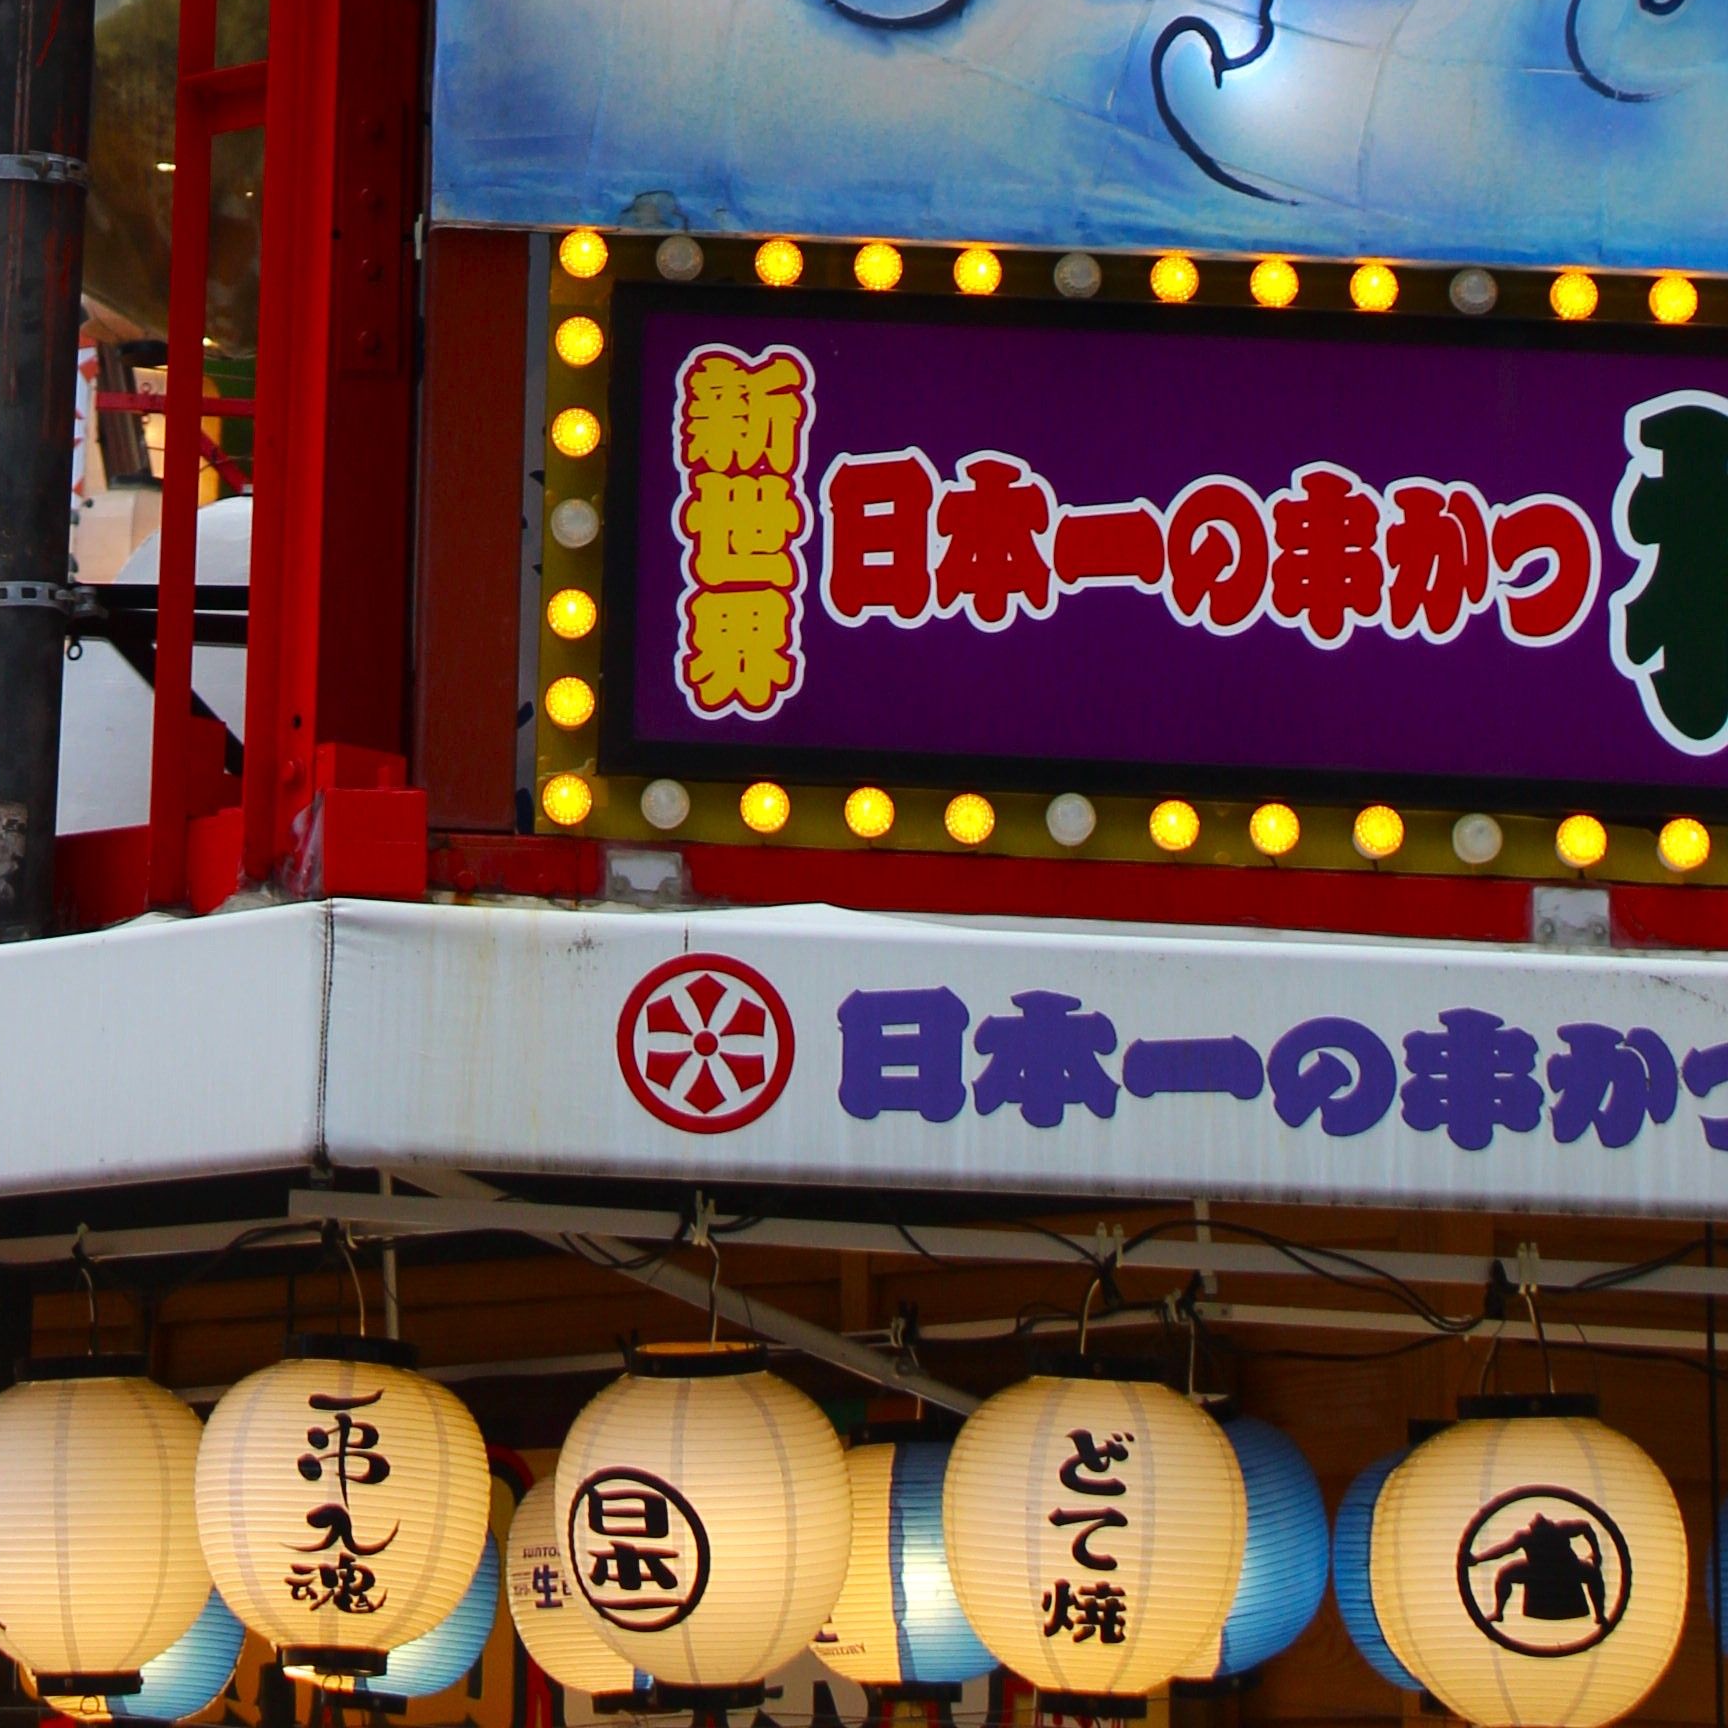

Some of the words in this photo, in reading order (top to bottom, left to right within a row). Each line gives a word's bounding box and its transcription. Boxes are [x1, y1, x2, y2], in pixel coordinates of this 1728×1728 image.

[680, 350, 810, 714] 新世界
[825, 450, 1597, 644] 日本一の串かつ
[280, 1386, 402, 1614] 一串入魂
[1041, 1427, 1136, 1644] どて焼
